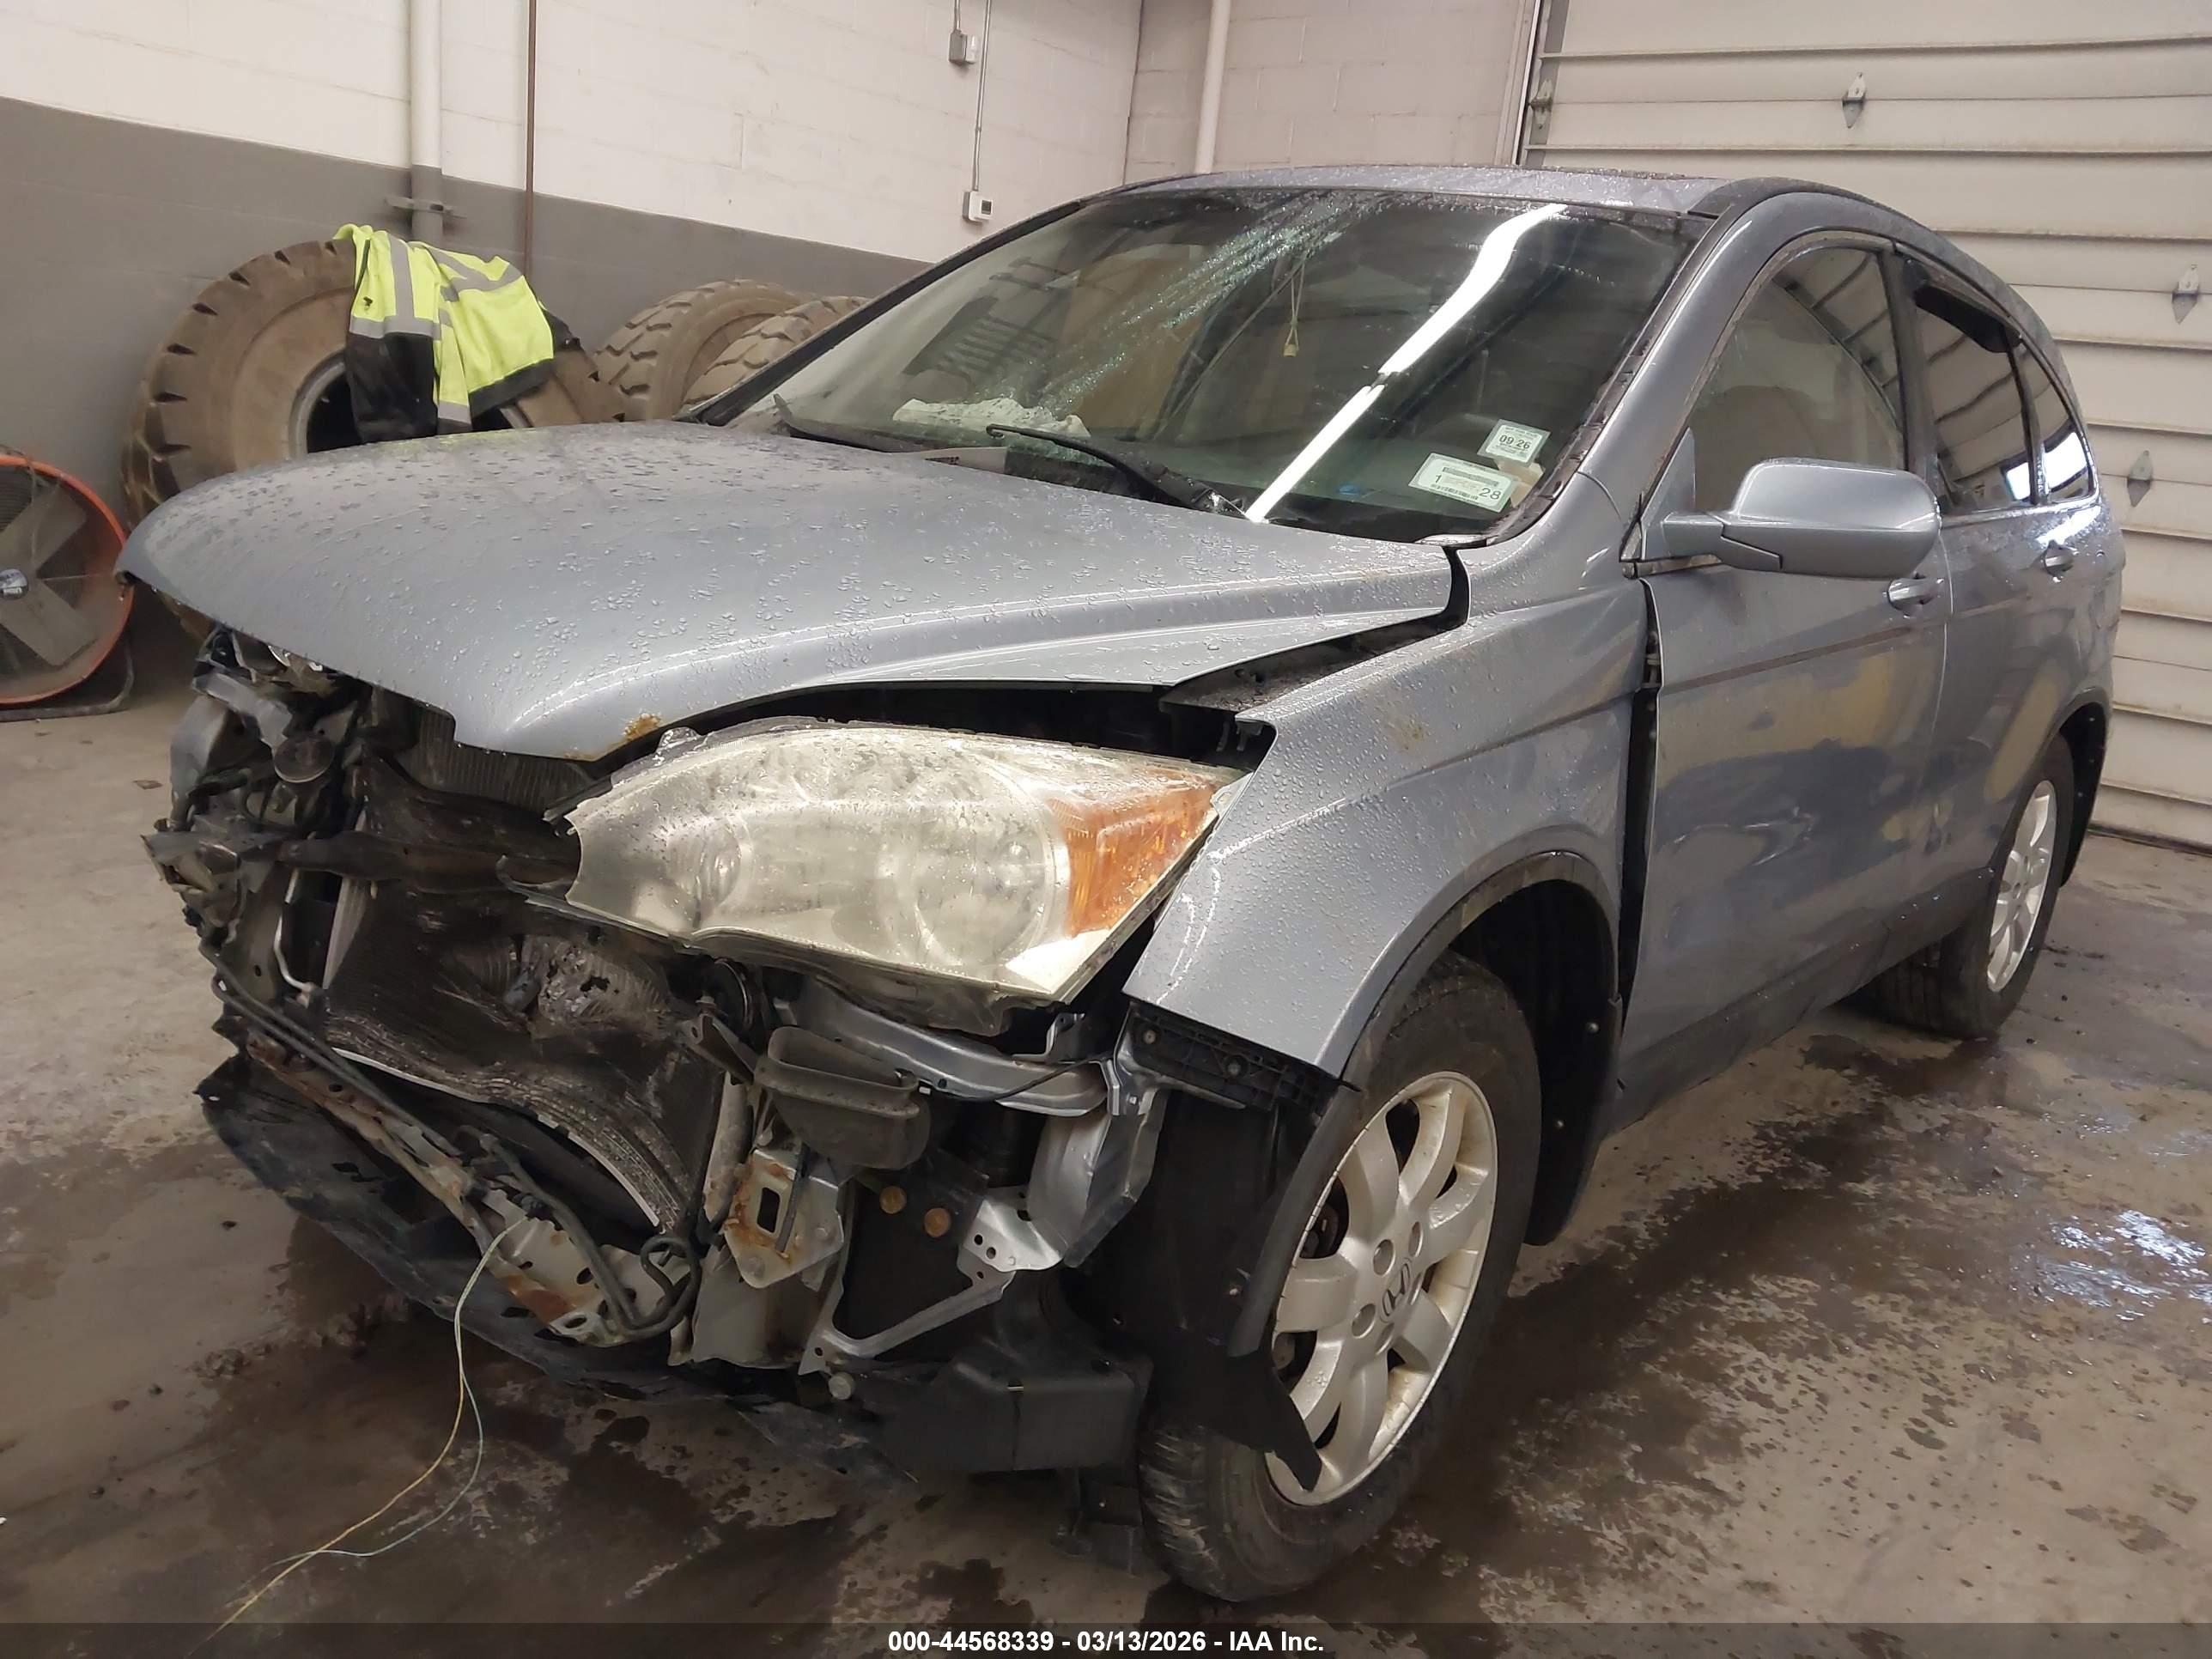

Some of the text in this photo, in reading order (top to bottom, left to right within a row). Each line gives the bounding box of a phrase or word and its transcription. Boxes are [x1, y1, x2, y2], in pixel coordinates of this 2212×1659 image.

[1499, 434, 1514, 444] 09
[1516, 439, 1531, 449] 26
[1480, 487, 1501, 500] 28
